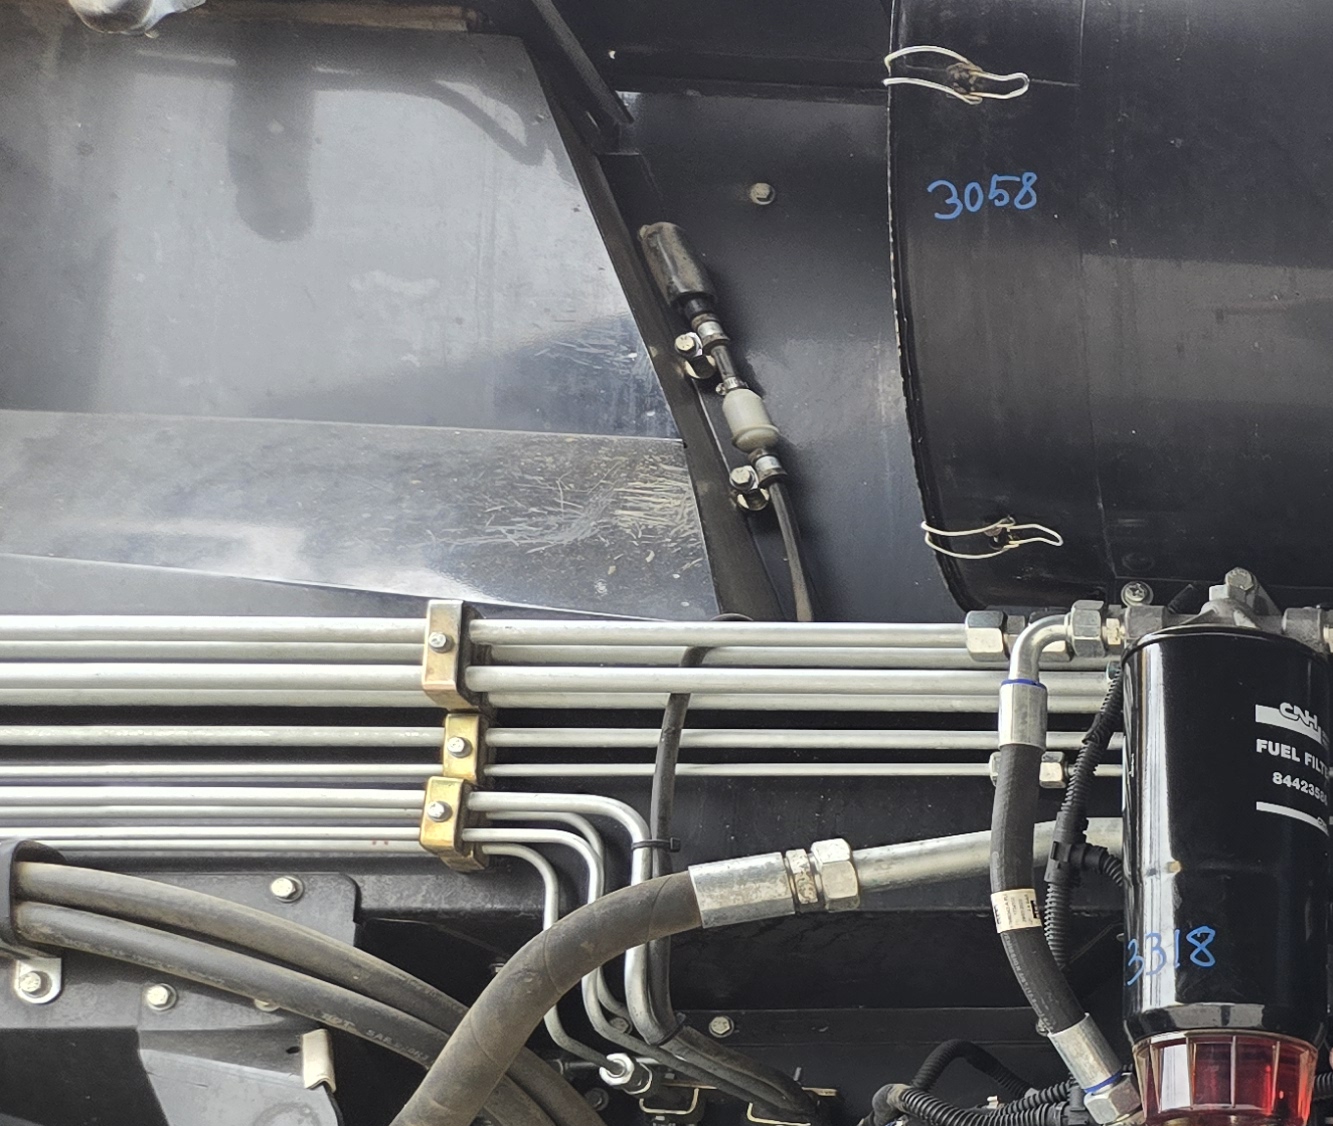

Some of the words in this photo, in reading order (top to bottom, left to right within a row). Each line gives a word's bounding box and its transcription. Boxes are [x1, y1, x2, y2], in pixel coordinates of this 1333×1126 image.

[926, 171, 1038, 221] 3058
[1256, 738, 1301, 763] FUEL
[1125, 925, 1217, 986] 3318
